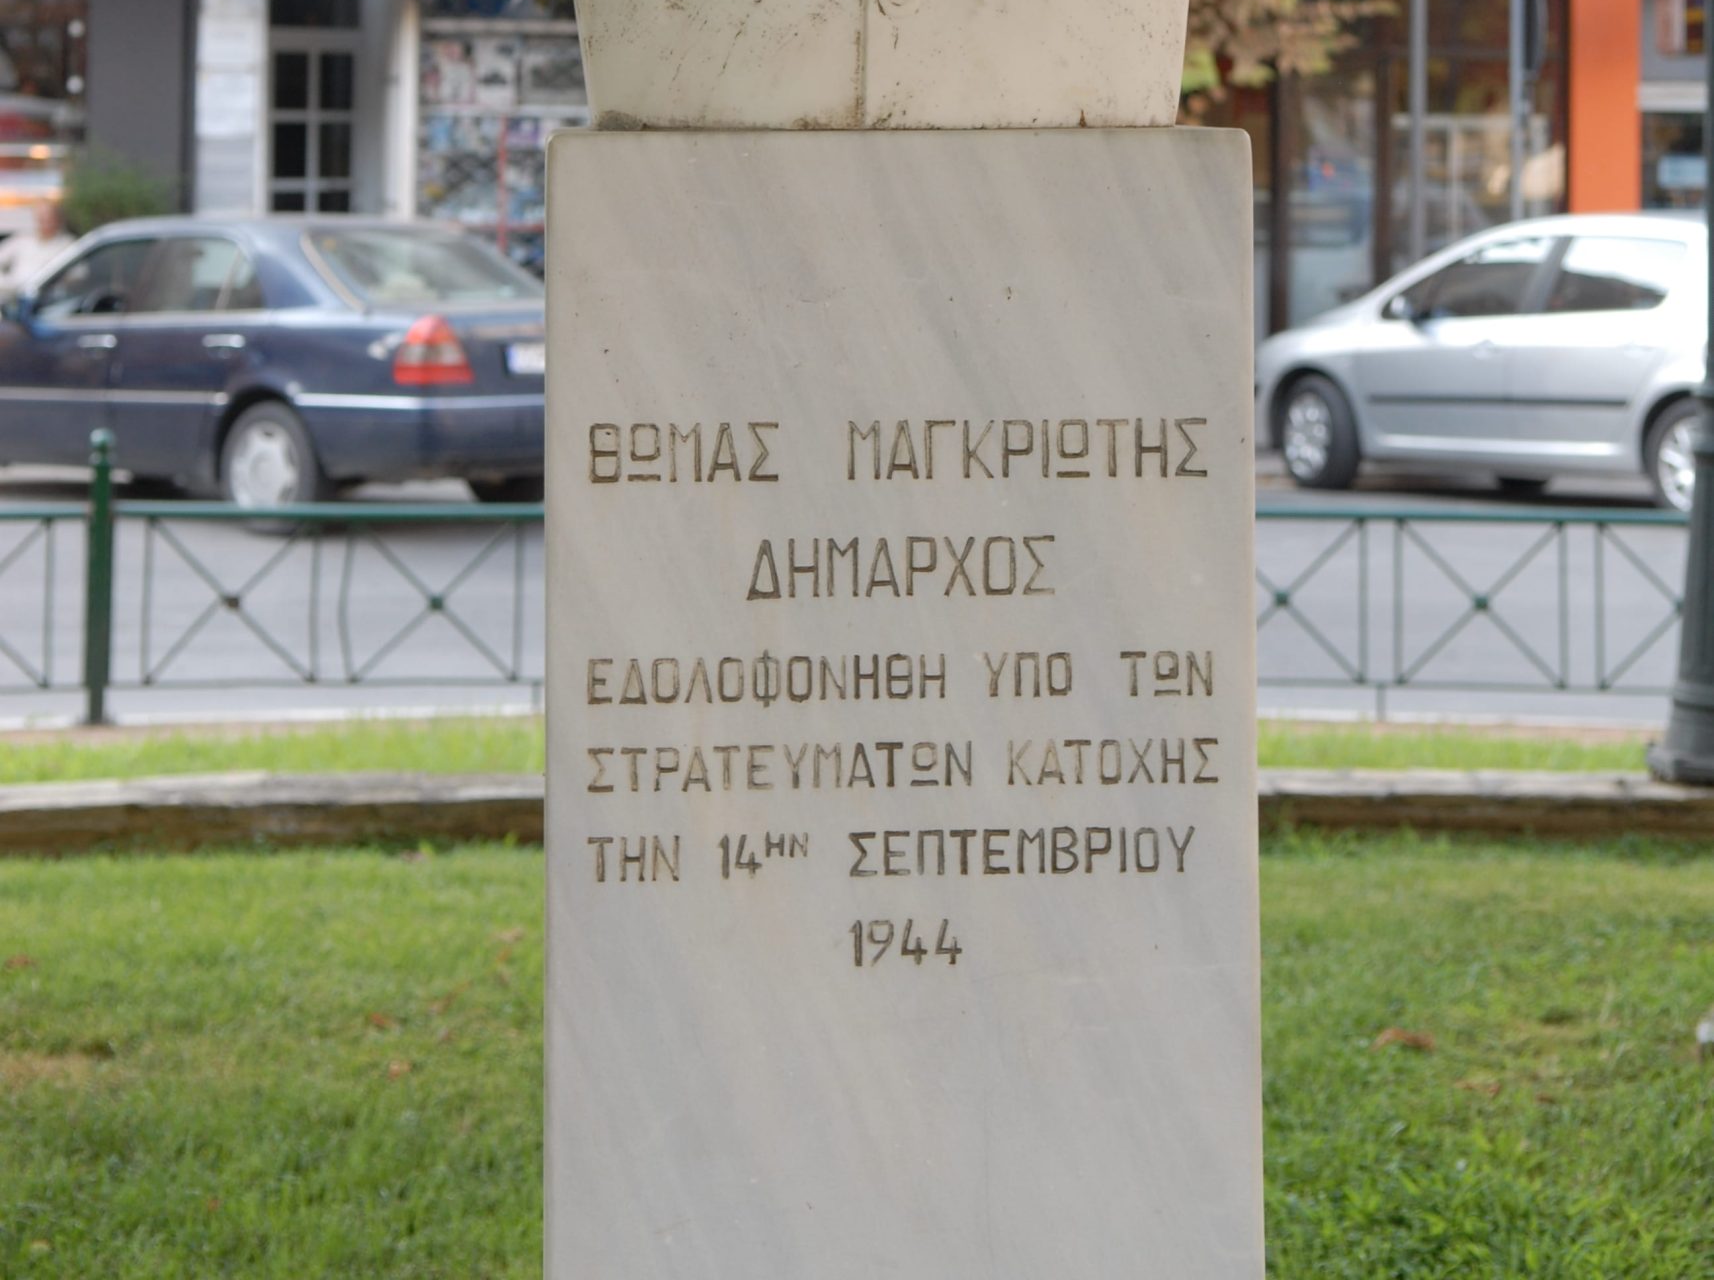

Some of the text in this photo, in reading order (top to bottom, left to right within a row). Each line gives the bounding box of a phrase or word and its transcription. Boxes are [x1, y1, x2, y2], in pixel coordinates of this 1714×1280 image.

[588, 417, 1209, 484] ΘΩΜΑΣ ΜΑΓΚΡΙΩΤΗΣ
[746, 535, 1056, 601] ΔΗΜΑΡΧΟΣ
[586, 650, 1214, 708] ΕΔΟΛΟΦΟΝΗΘΗ ΥΠΟ ΤΩΝ
[586, 737, 1220, 793] ΣΤΡΑΤΕΥΜΑΤΩΝ ΚΑΤΟΧΗΣ
[586, 834, 681, 882] ΤΗΝ
[847, 826, 1196, 878] ΣΕΠΤΕΜΒΡΙΟΥ
[849, 919, 963, 968] 1944
